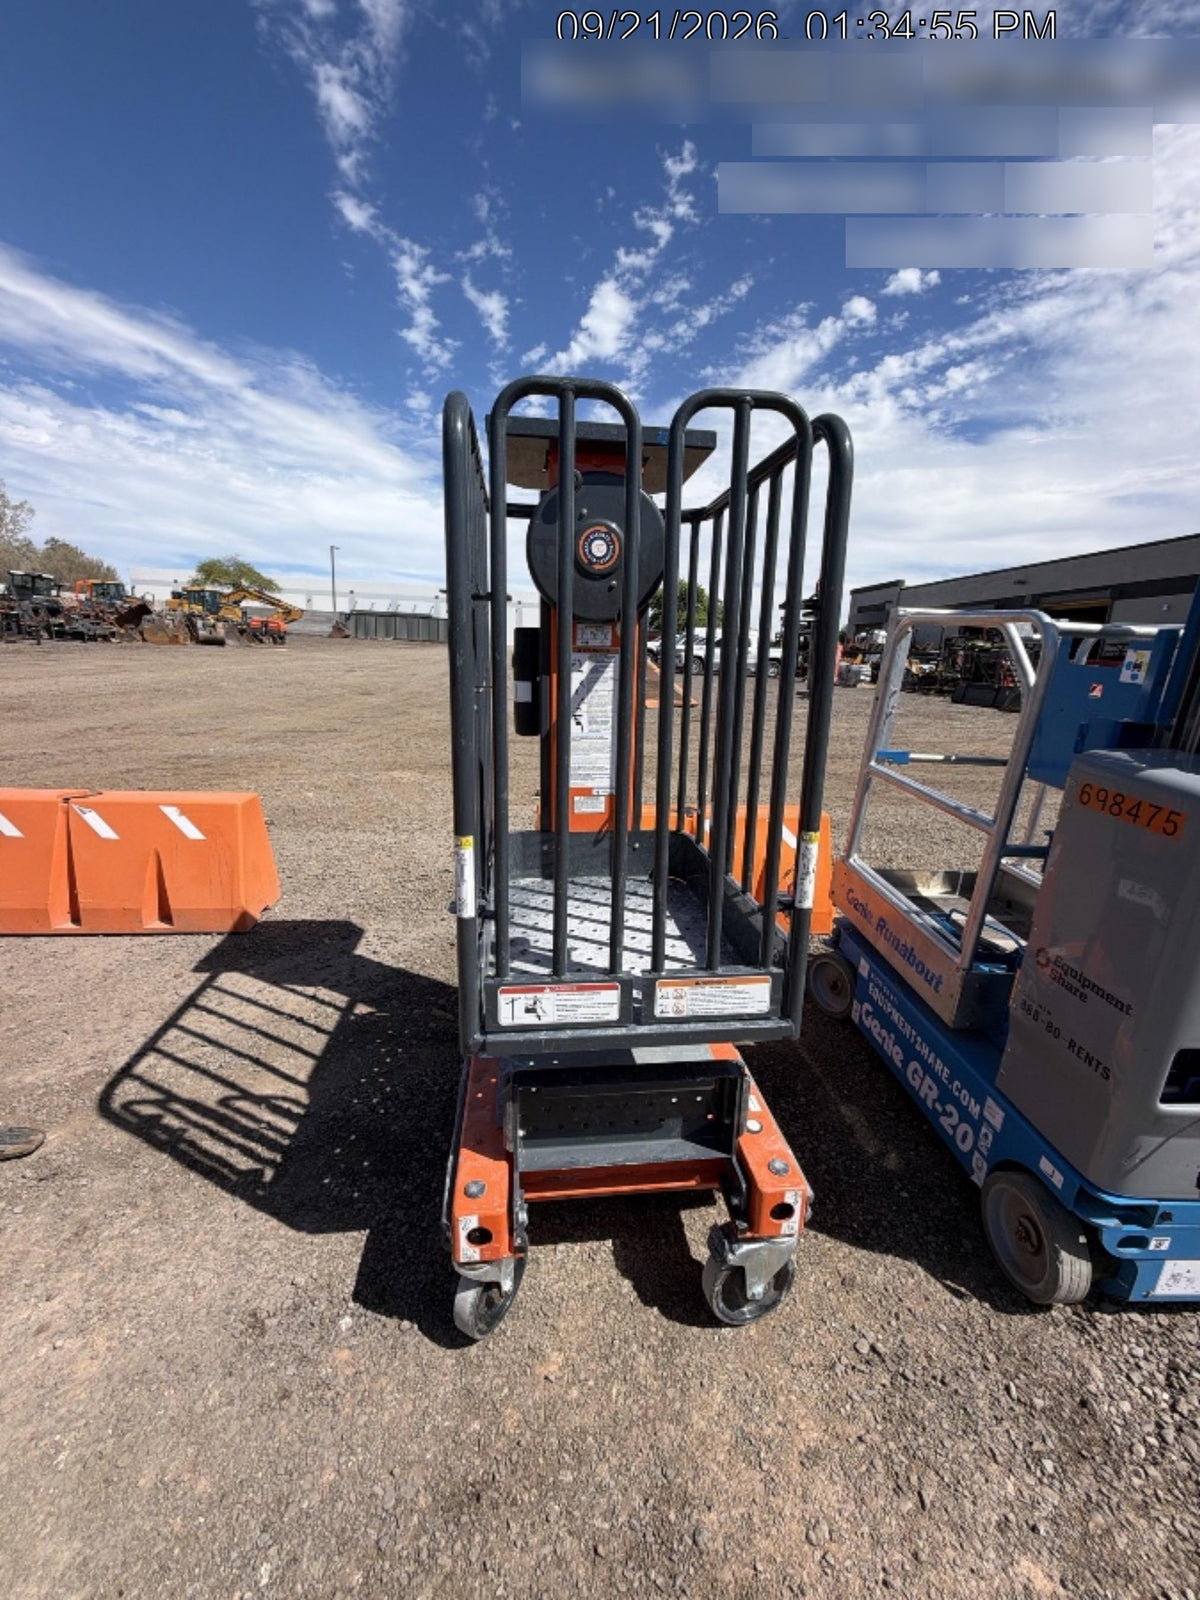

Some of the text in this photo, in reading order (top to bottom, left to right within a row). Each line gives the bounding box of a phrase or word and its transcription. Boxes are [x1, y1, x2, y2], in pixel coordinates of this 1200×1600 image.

[1079, 783, 1181, 836] 698475
[875, 917, 943, 994] Runabout
[1048, 967, 1088, 1003] Share
[1053, 955, 1134, 1017] Equipment
[860, 1001, 905, 1069] Genie
[906, 1060, 975, 1152] GR-20
[868, 981, 981, 1120] EQUIPMENTSHARE.COM
